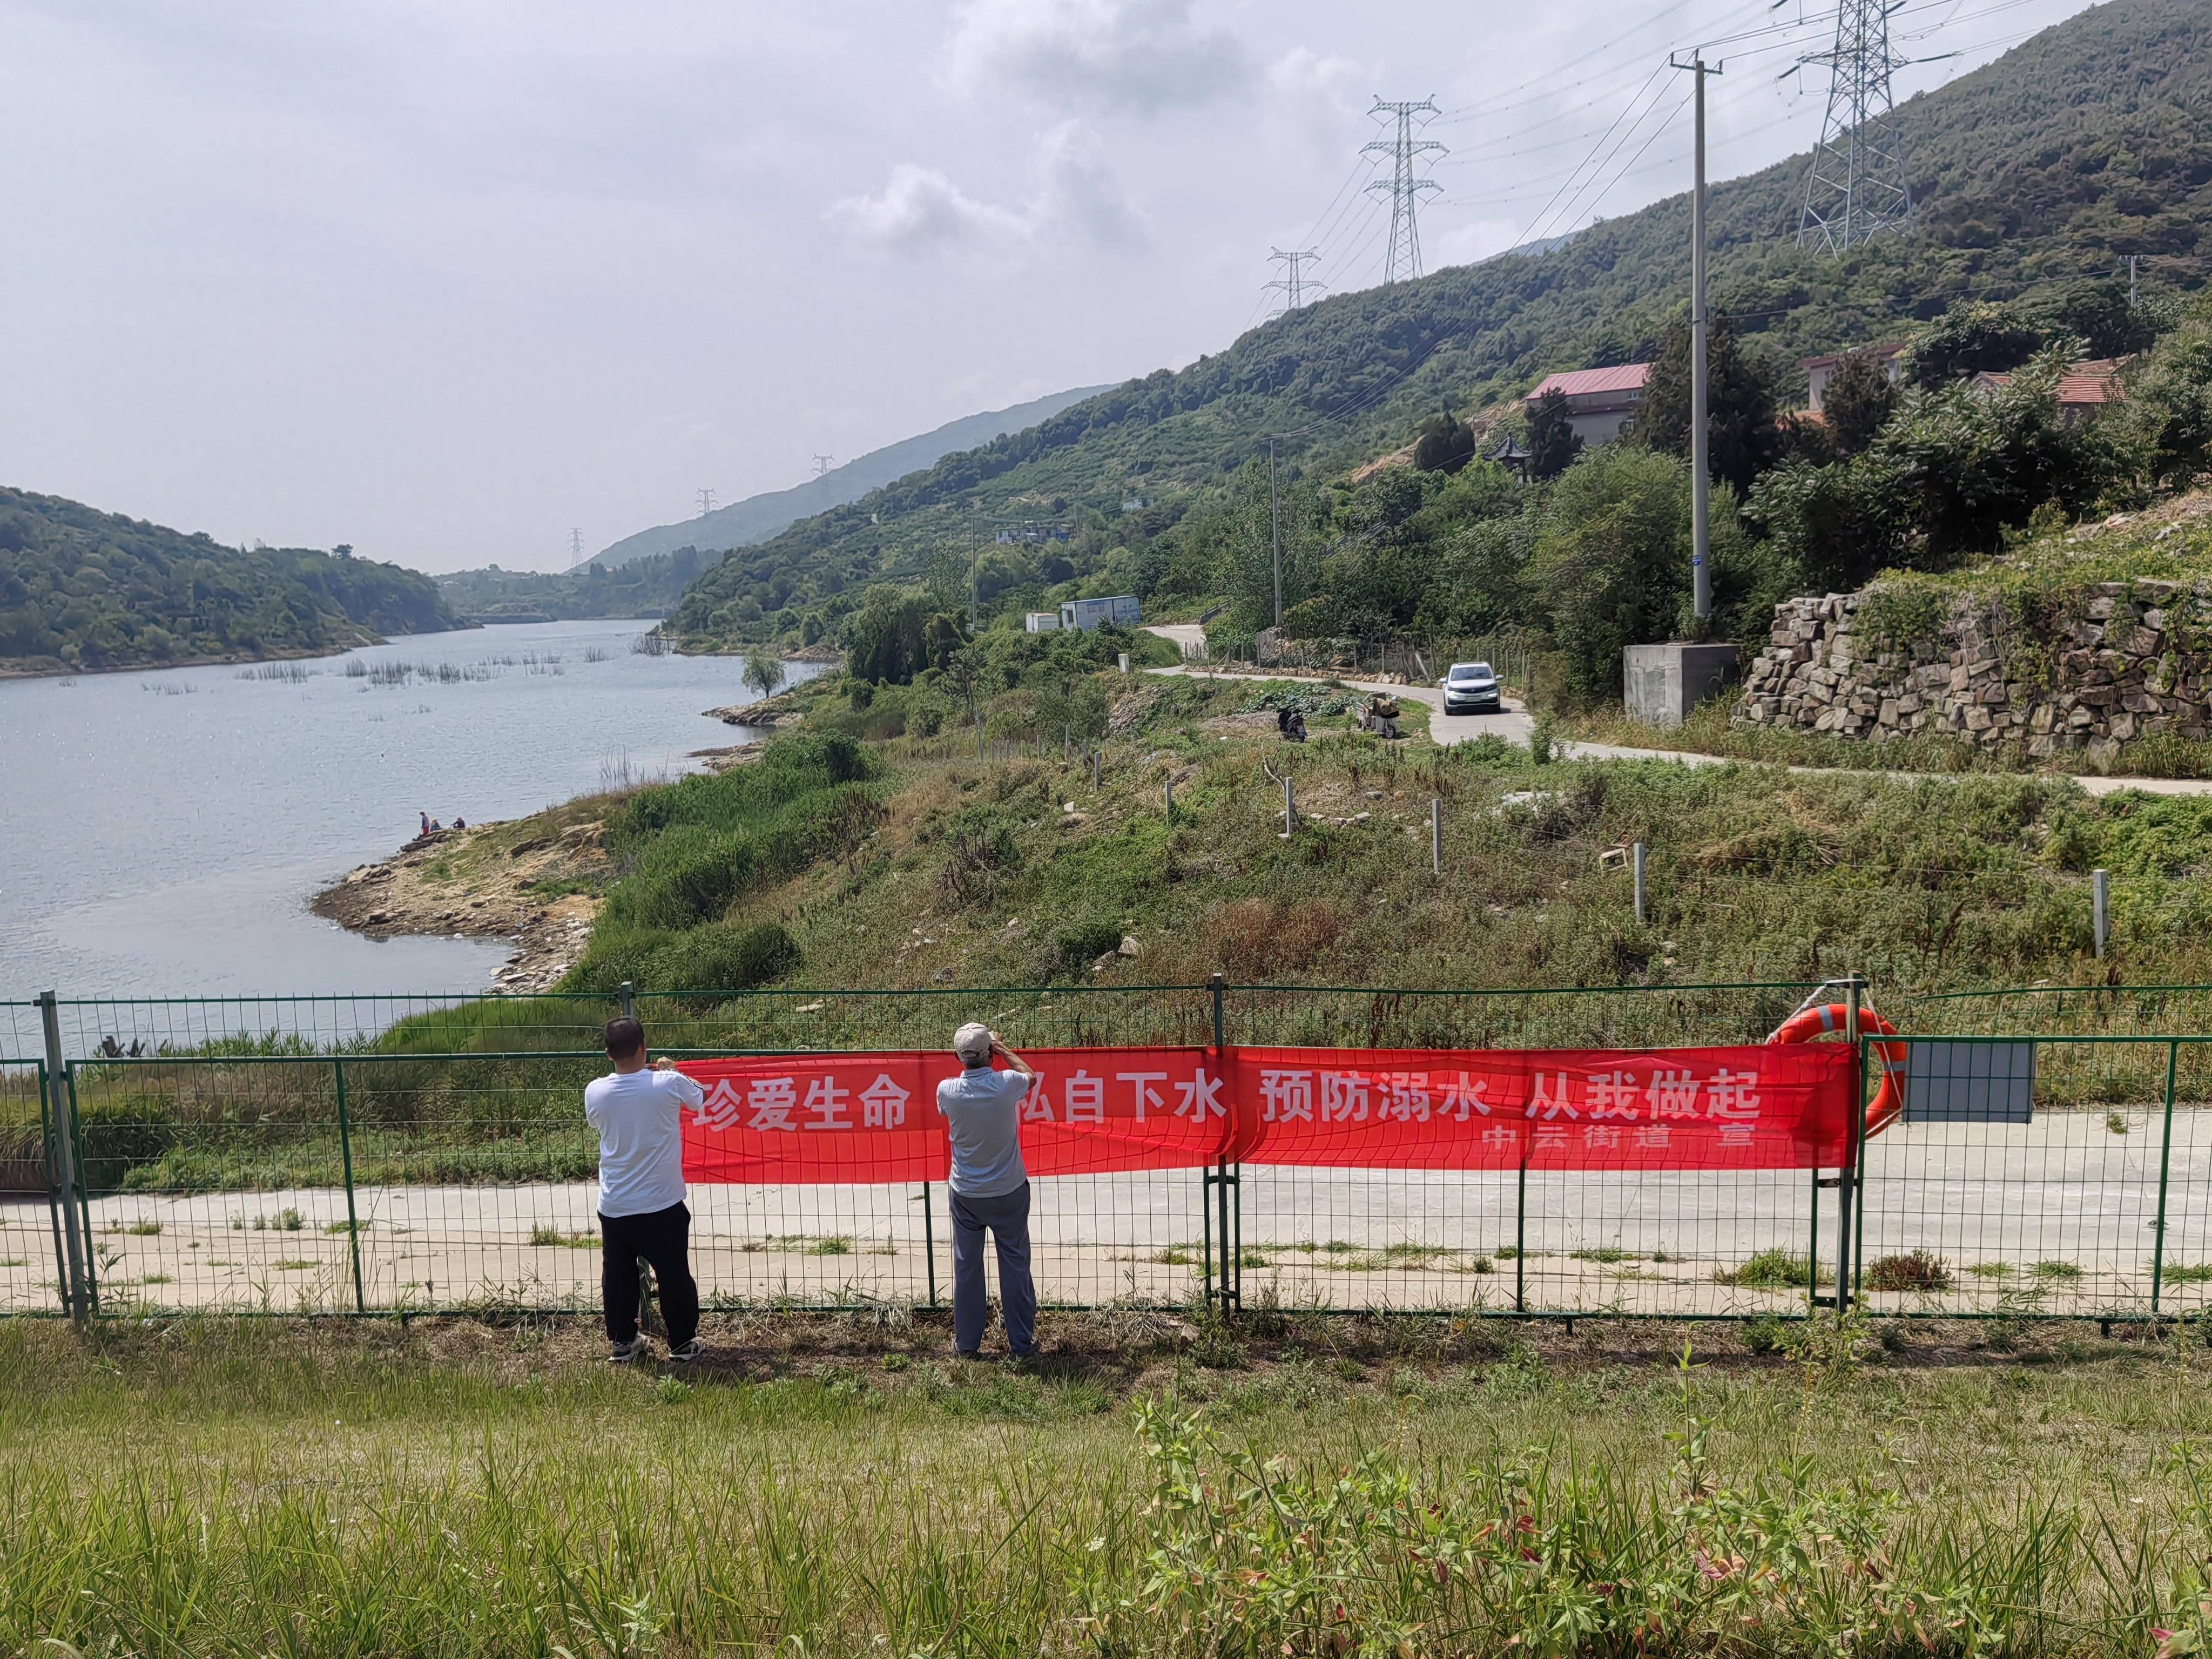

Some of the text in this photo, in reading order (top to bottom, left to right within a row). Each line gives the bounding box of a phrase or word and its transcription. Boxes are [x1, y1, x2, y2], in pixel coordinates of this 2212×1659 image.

[692, 1073, 911, 1132] 珍爱生命
[1259, 1069, 1492, 1123] 预防溺水
[1525, 1068, 1761, 1121] 从我做起
[1481, 1124, 1673, 1150] 中云街道
